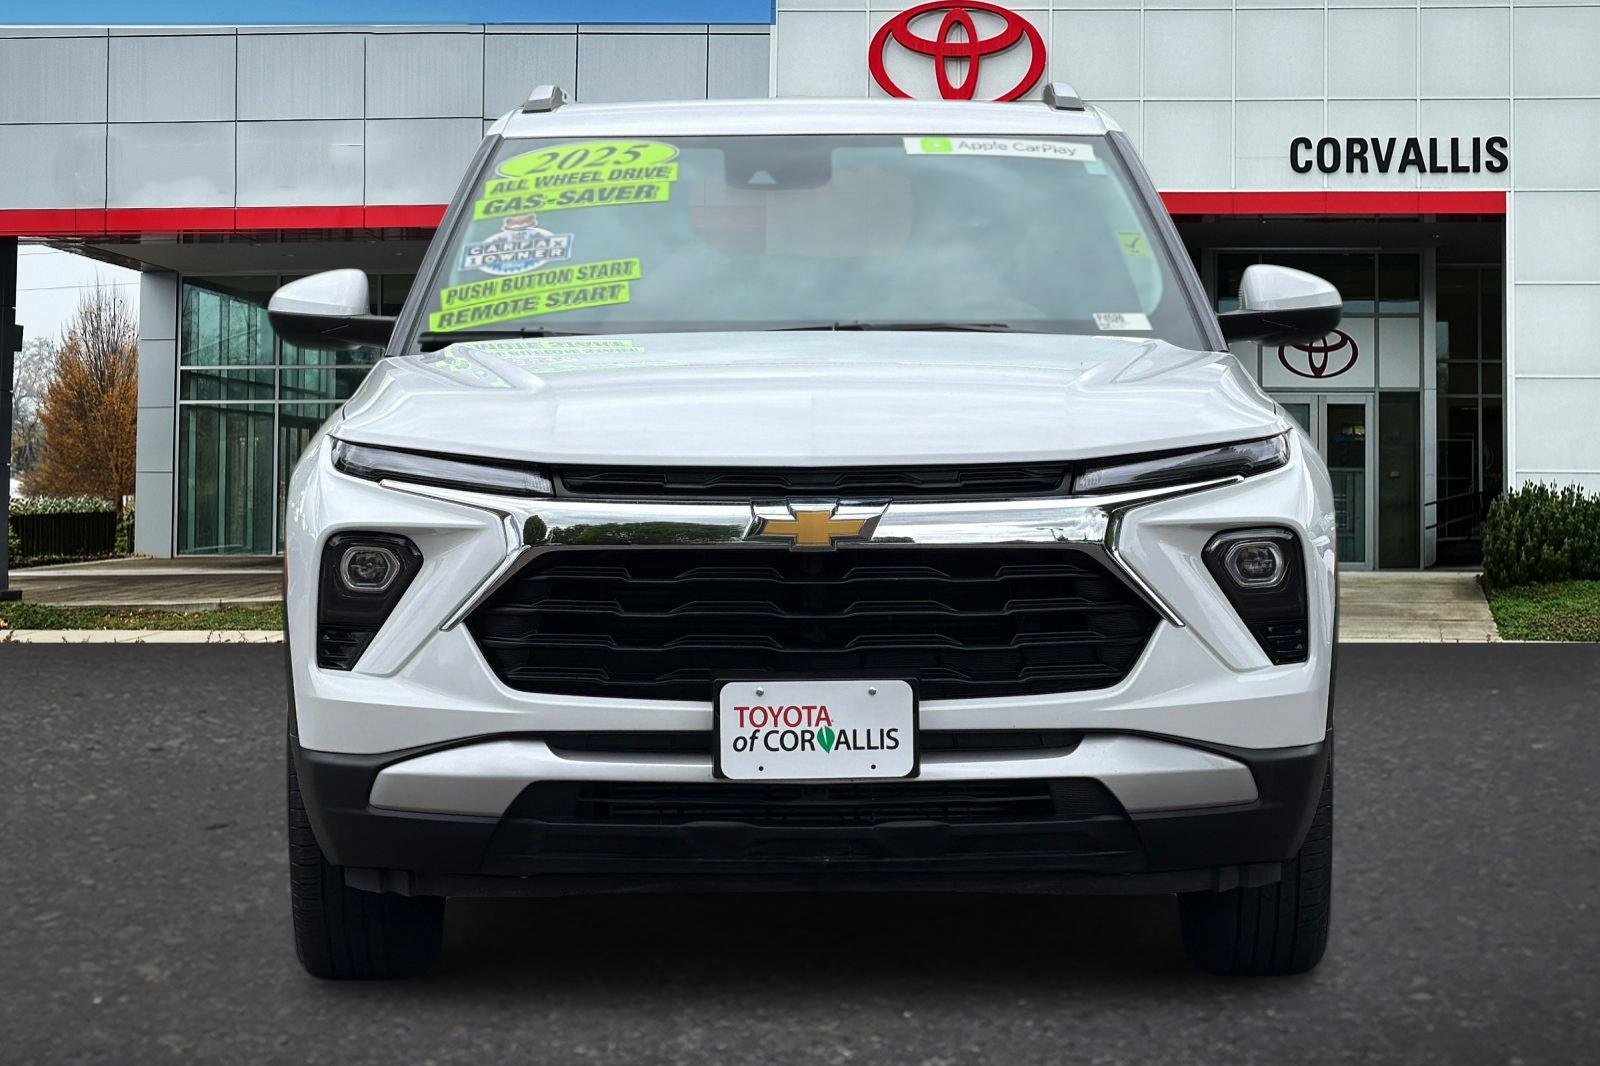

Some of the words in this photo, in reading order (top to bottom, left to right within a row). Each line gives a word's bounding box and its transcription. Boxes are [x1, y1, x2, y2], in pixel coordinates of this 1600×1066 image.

[527, 143, 650, 175] 2025
[958, 139, 1008, 153] Apple
[1012, 142, 1077, 157] CarPlay
[1289, 136, 1509, 174] CORVALLIS
[490, 176, 530, 195] ALL
[534, 170, 603, 188] WHEEL
[607, 165, 672, 181] DRIVE
[482, 183, 660, 215] GAS-SAVER
[469, 238, 564, 255] CARFAX
[484, 248, 563, 263] OWNER
[445, 282, 498, 305] PUSH
[501, 269, 573, 293] BUTTON
[576, 259, 637, 281] START
[437, 296, 540, 328] REMOTE
[545, 283, 626, 307] START
[733, 705, 833, 728] TOYOTA
[732, 729, 761, 752] of
[764, 727, 900, 753] CORVALLIS
